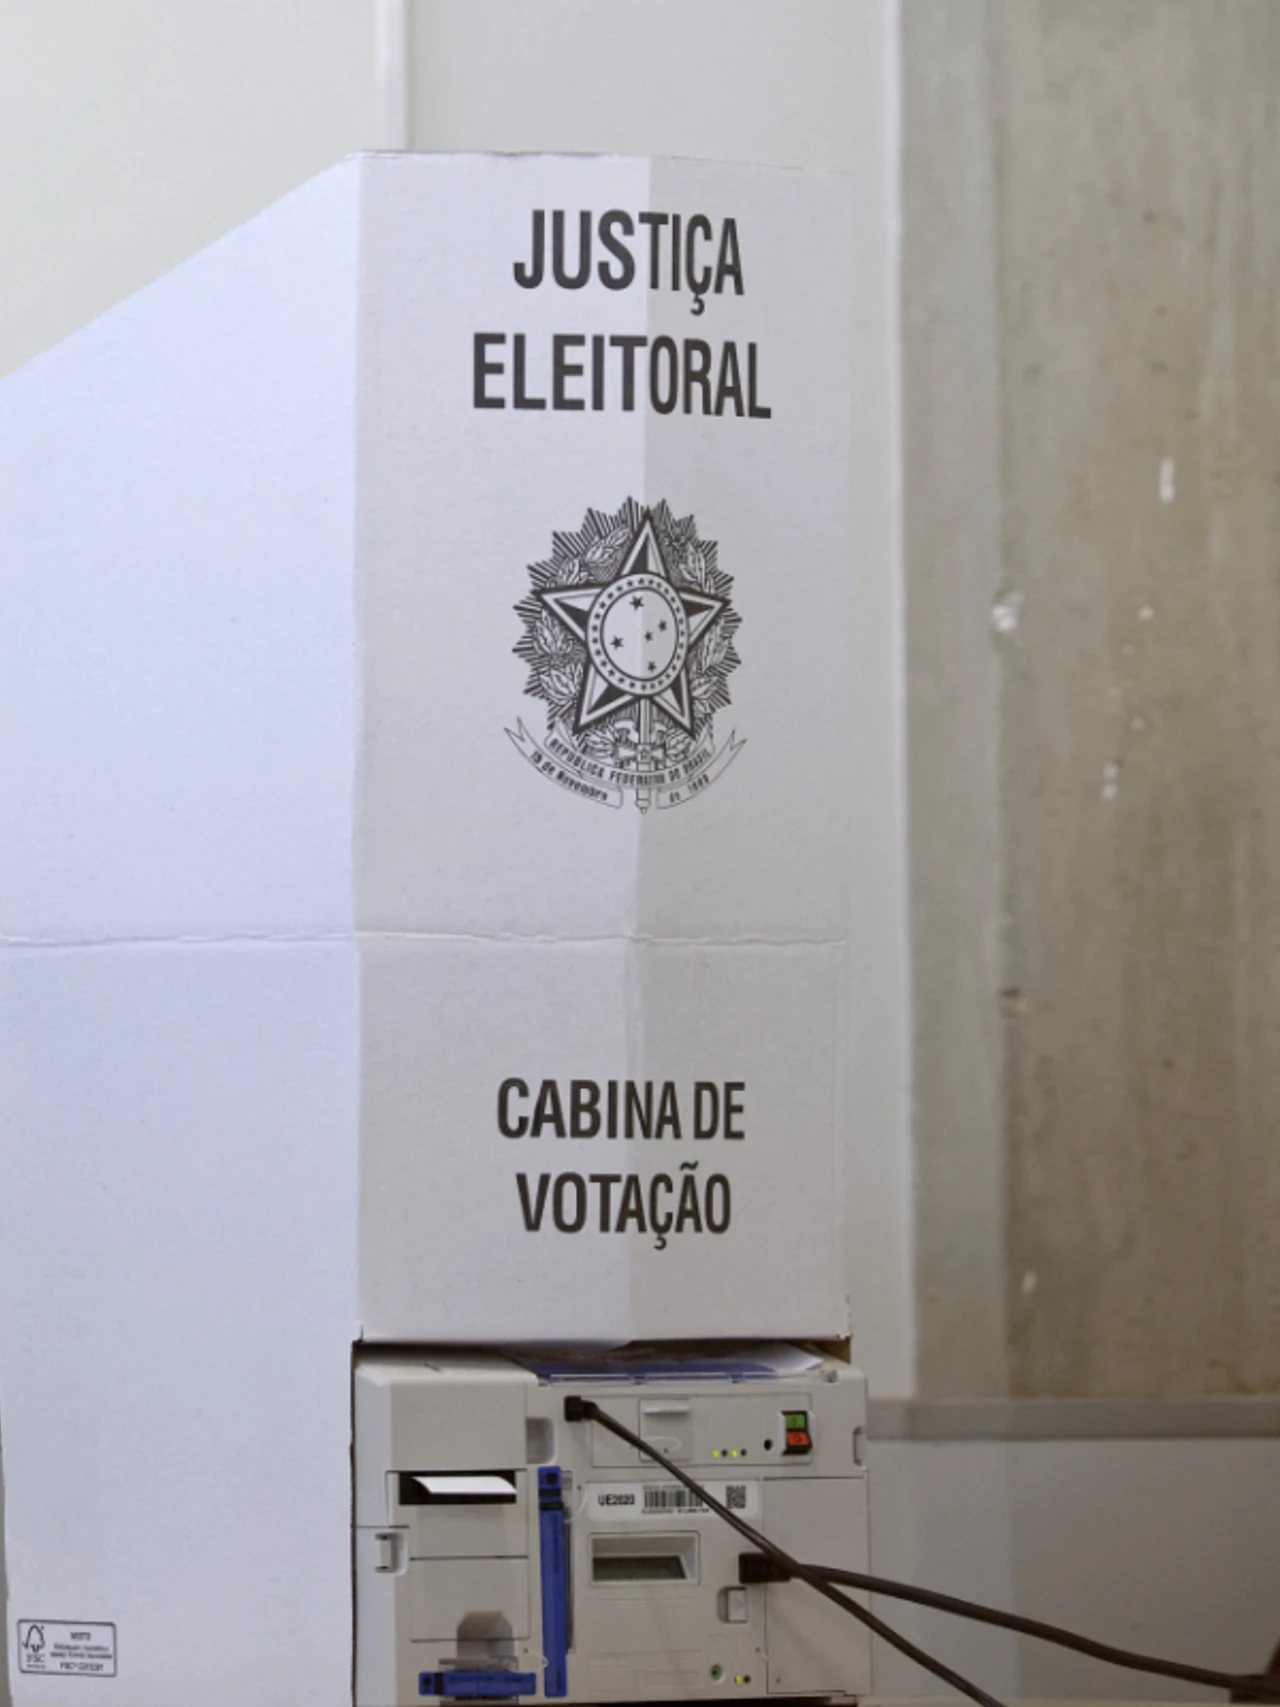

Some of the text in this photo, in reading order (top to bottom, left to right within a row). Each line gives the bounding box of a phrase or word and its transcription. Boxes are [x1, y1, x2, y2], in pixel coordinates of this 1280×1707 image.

[513, 209, 744, 316] JUSTIÇA
[473, 332, 772, 419] ELEITORAL
[497, 1077, 746, 1140] CABINA DE
[516, 1160, 732, 1251] VOTAÇÃO
